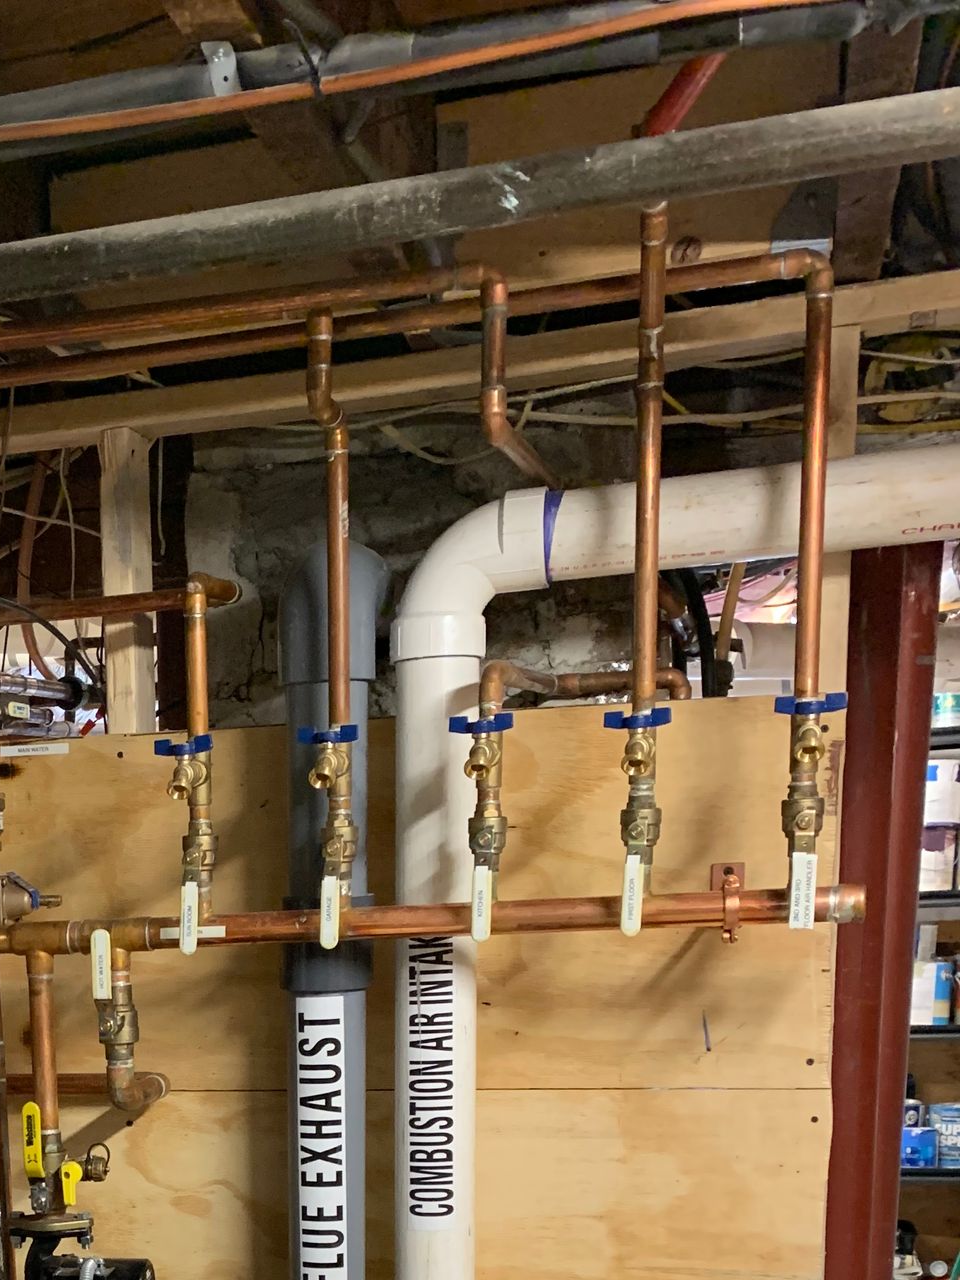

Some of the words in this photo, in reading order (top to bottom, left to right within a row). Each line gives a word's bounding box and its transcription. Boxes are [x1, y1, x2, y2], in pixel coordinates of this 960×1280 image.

[901, 521, 960, 535] CHA
[627, 877, 635, 901] FLOOR
[804, 860, 813, 892] HANDLER
[627, 902, 635, 921] FIRST
[408, 936, 454, 1006] INTAK
[408, 1011, 454, 1052] AIR
[297, 1012, 343, 1188] EXHAUST
[408, 1058, 454, 1218] COMBUSTION
